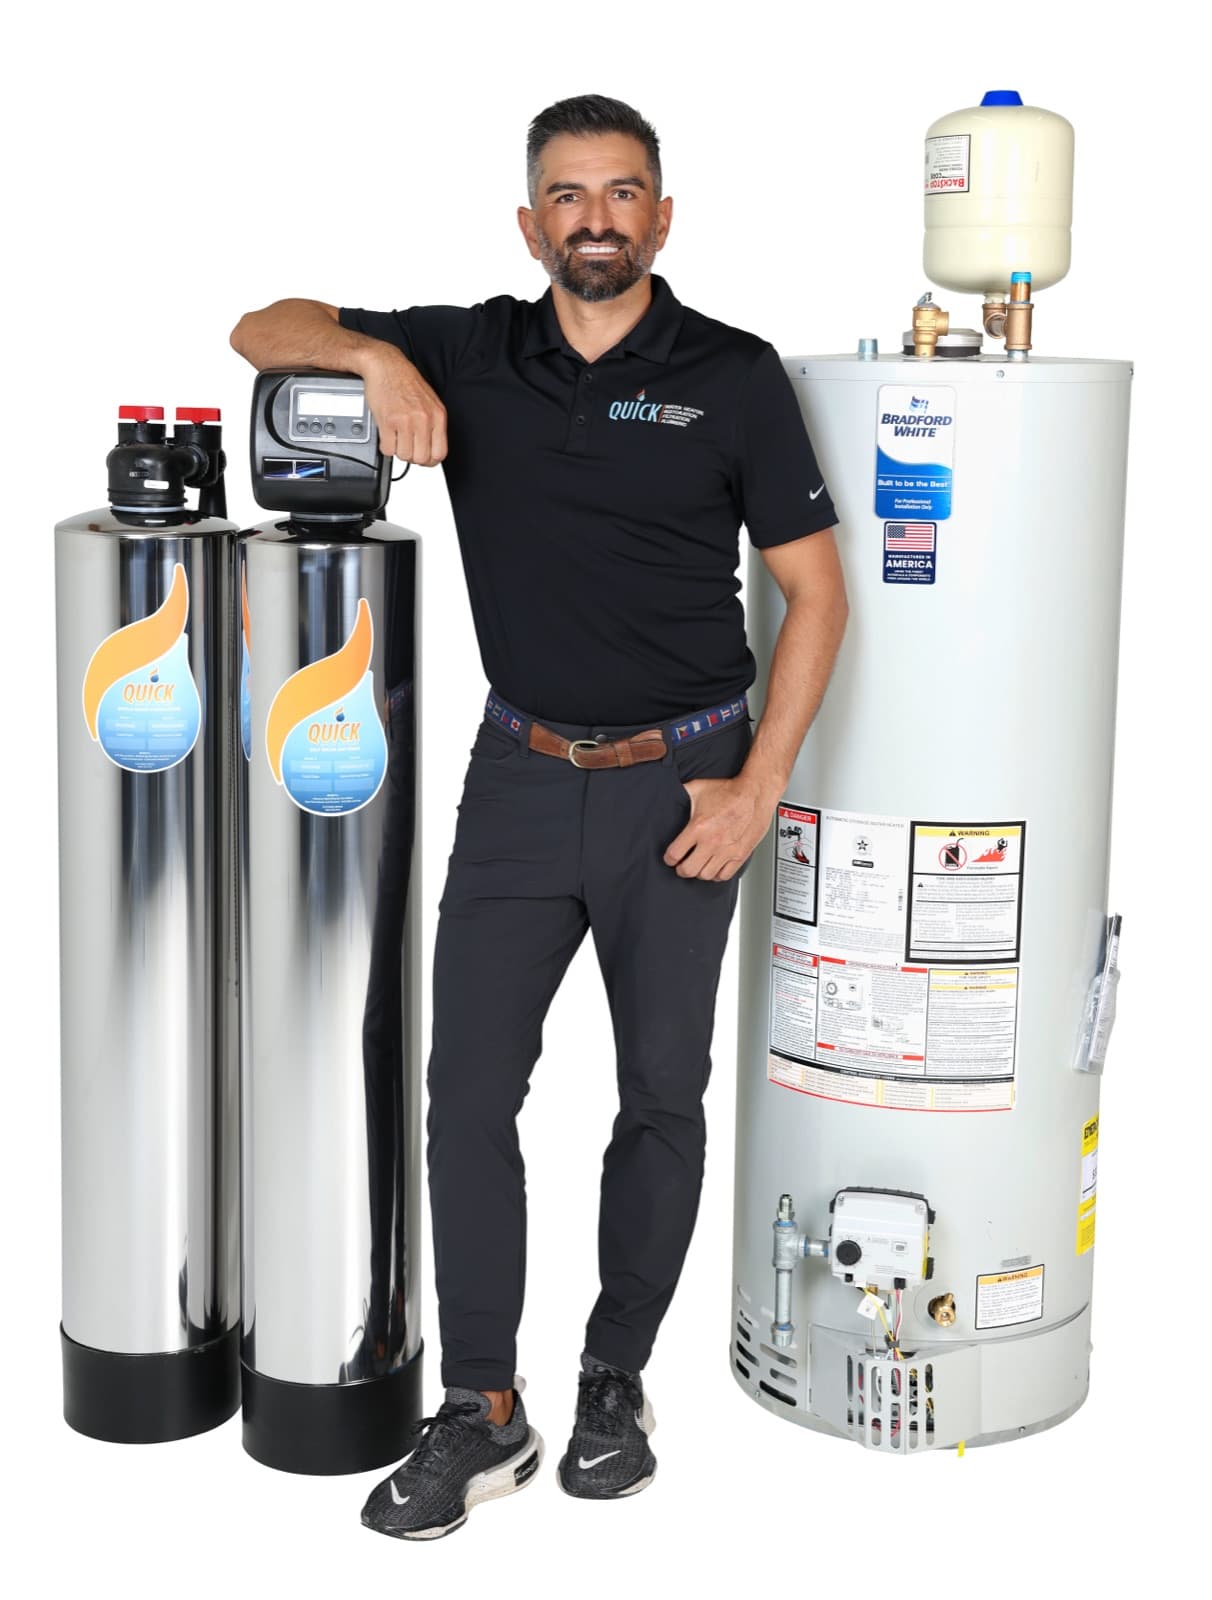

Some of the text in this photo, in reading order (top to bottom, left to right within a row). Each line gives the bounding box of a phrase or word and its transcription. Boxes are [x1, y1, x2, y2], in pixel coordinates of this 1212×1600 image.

[608, 401, 663, 423] QUICK
[880, 413, 953, 426] BRADFORD
[893, 426, 937, 438] WHITE
[877, 479, 894, 487] Built
[929, 480, 948, 488] Best
[885, 559, 933, 568] AMERICA
[122, 683, 176, 704] QUICK
[307, 722, 362, 744] QUICK
[789, 811, 812, 823] DANGER
